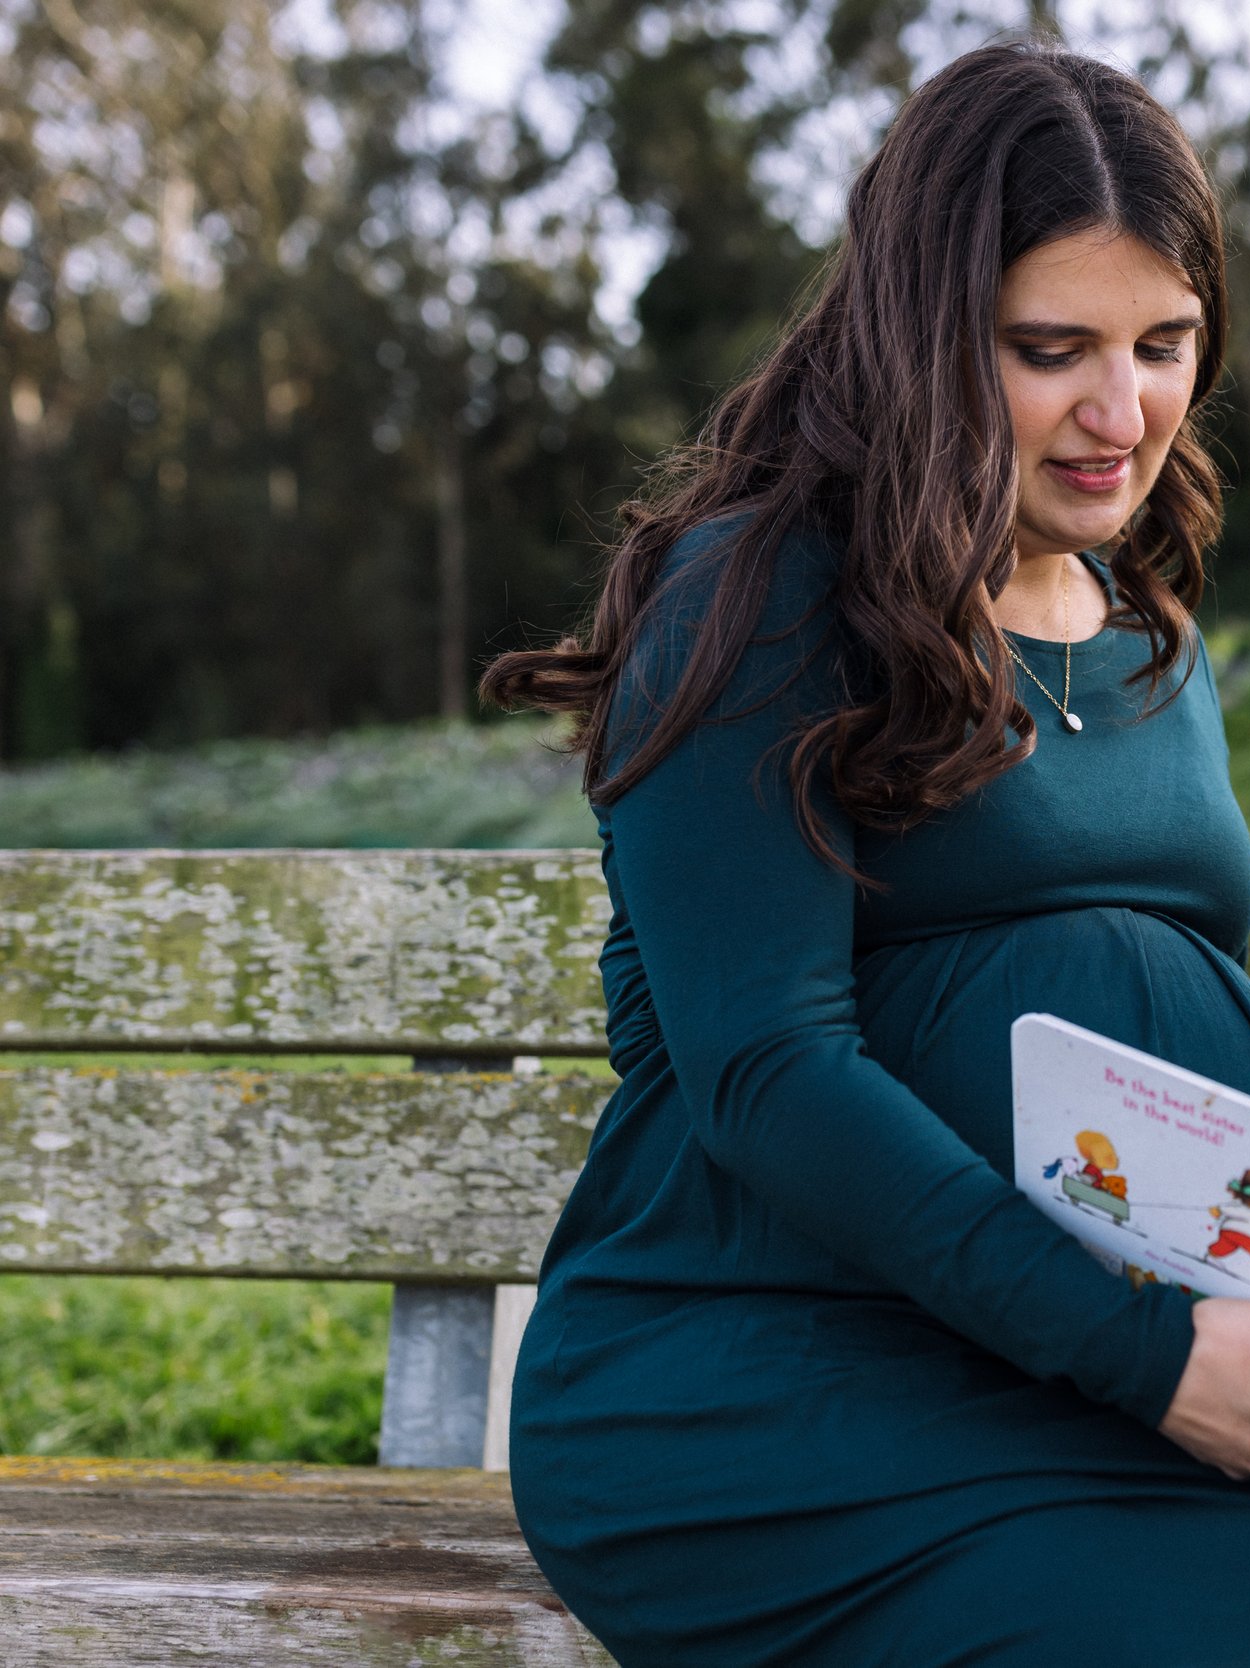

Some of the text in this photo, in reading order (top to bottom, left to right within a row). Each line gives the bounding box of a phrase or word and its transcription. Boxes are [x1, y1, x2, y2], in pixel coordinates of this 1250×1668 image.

[1132, 1080, 1156, 1100] the
[1163, 1089, 1195, 1117] best
[1202, 1111, 1245, 1136] sister
[1144, 1103, 1169, 1124] the
